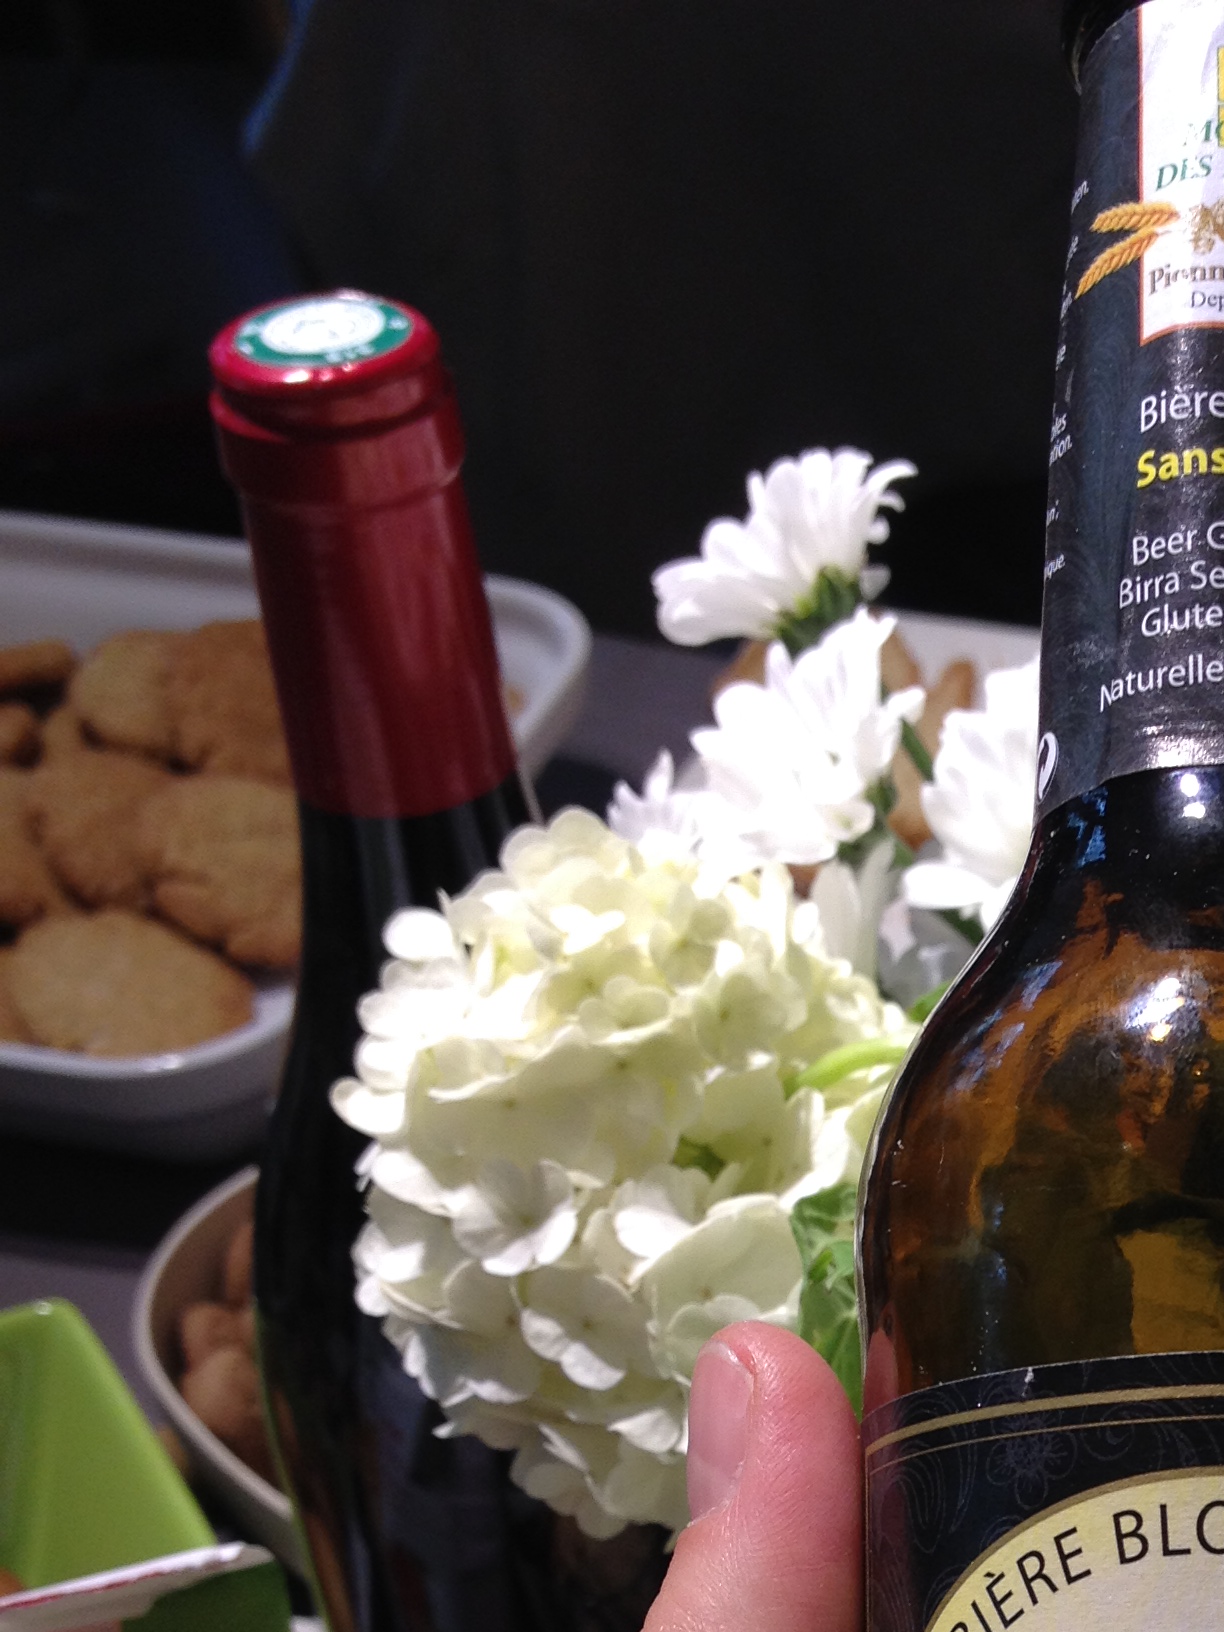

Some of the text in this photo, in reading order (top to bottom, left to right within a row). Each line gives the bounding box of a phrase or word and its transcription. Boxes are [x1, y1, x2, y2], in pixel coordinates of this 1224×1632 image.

[1155, 154, 1213, 192] DES
[1132, 526, 1199, 567] Beer
[1118, 569, 1180, 610] Birra
